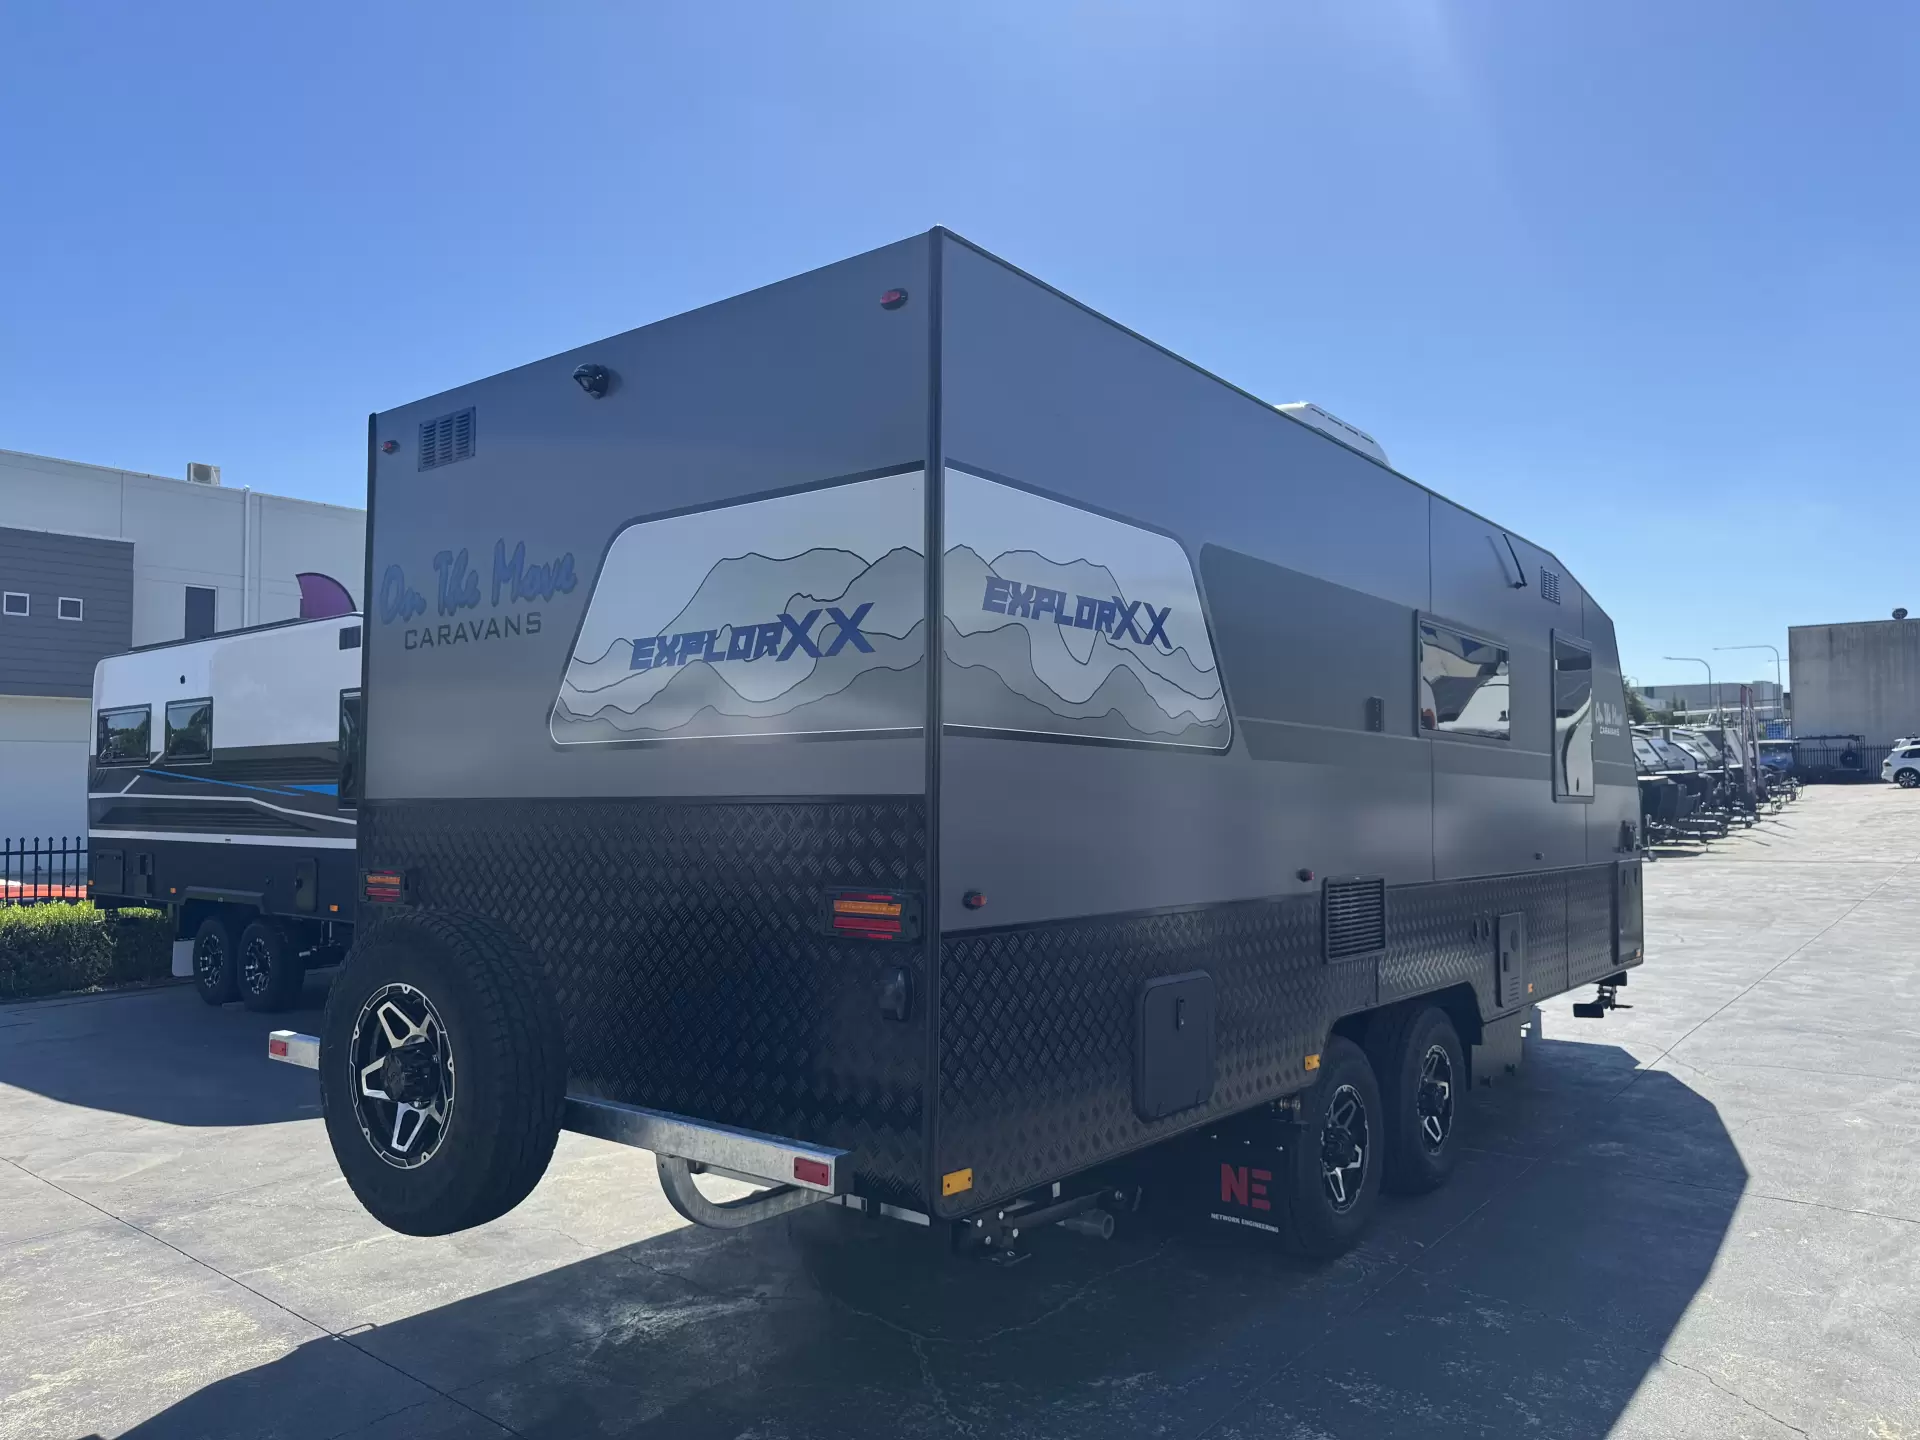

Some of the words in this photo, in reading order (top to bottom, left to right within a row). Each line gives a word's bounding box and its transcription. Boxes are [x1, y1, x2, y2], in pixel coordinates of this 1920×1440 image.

[381, 565, 427, 624] On
[433, 548, 481, 616] The
[492, 538, 577, 606] Move
[404, 612, 542, 650] CARAVANS
[629, 602, 876, 670] EXPLORXX
[982, 576, 1172, 649] EXPLORXX
[1221, 1163, 1272, 1211] NE
[1211, 1213, 1240, 1224] NETWORK
[1241, 1218, 1279, 1233] ENGINEERING
